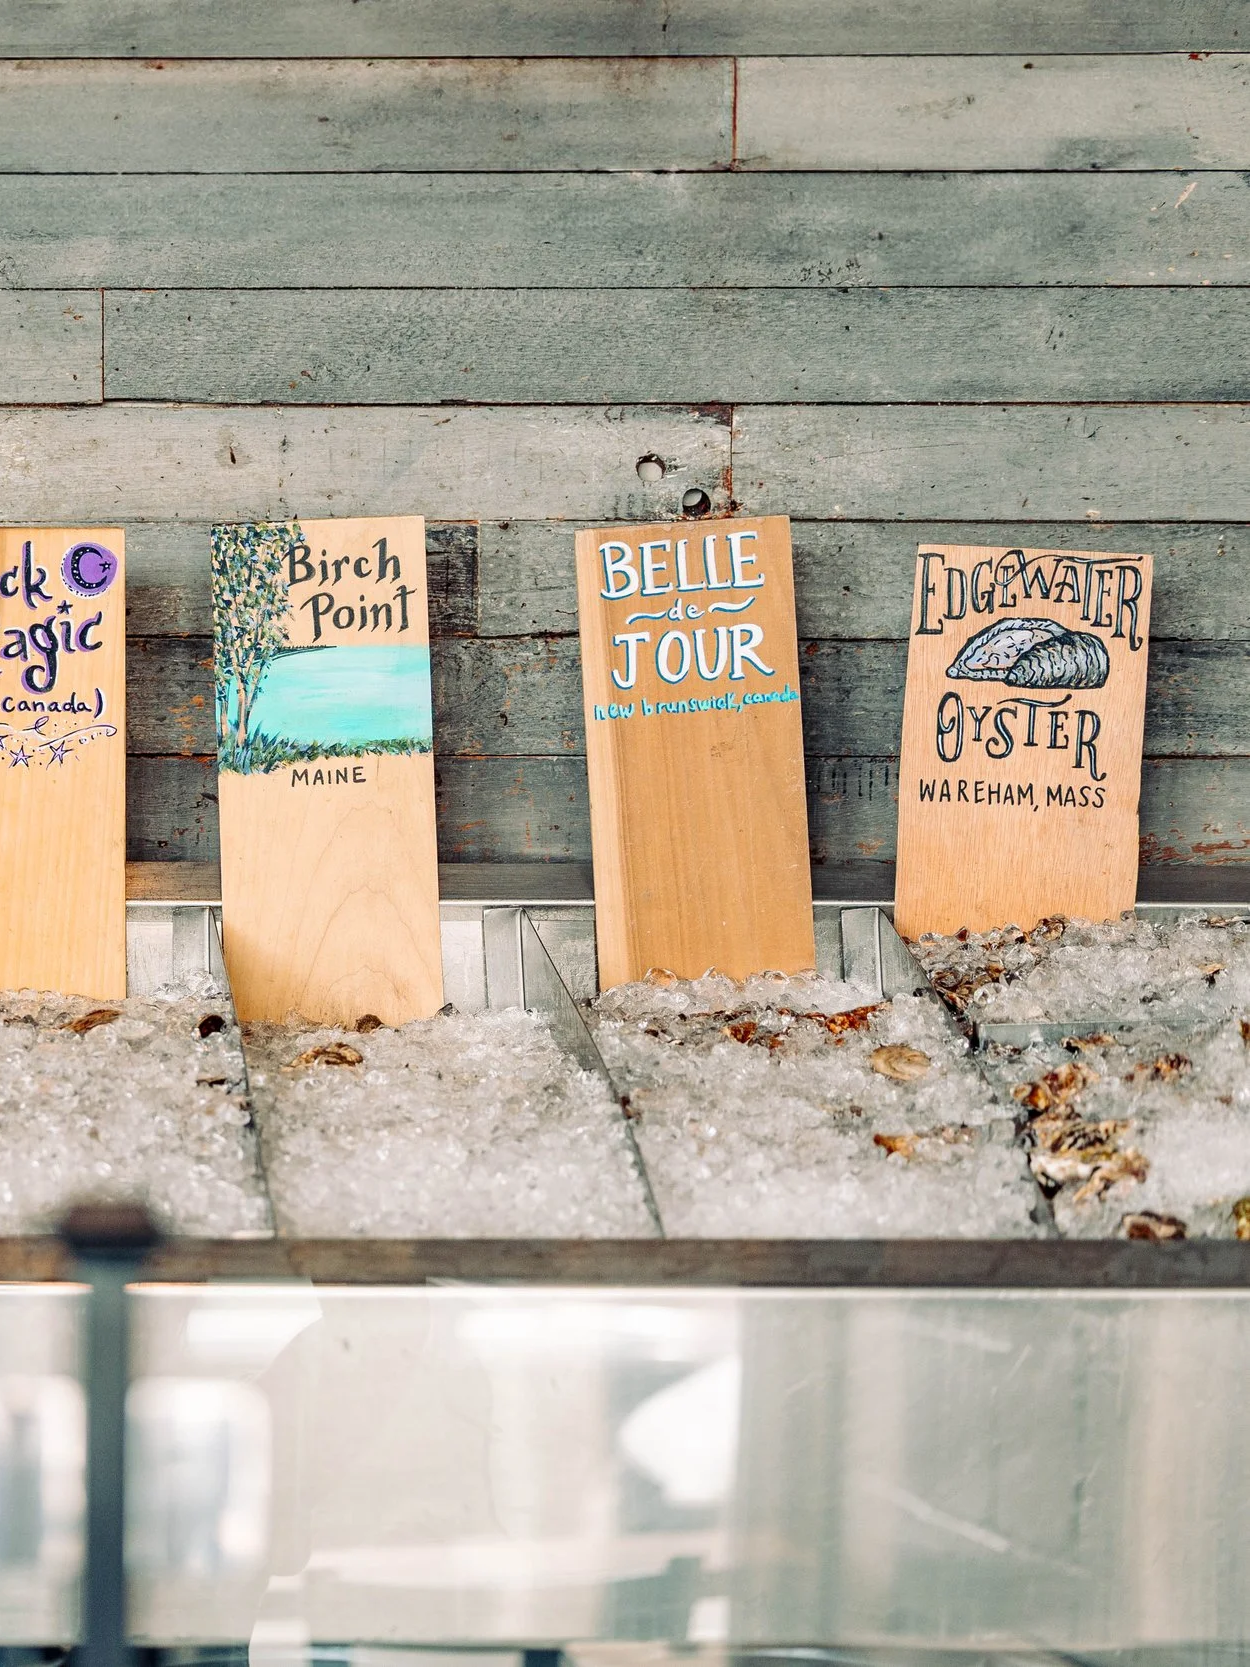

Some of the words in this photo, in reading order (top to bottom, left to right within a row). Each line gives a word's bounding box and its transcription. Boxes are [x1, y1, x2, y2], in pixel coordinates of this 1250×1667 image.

[281, 537, 402, 587] Birch
[599, 530, 765, 600] BELLE
[299, 584, 418, 643] Point
[667, 598, 705, 621] de
[914, 549, 1144, 652] EDGEWATER
[611, 623, 775, 691] JOUR
[594, 703, 635, 721] new
[936, 691, 1108, 782] OYSTER
[291, 766, 367, 787] MAINE
[919, 778, 1039, 812] WAREHAM,
[1046, 784, 1106, 809] MASS
